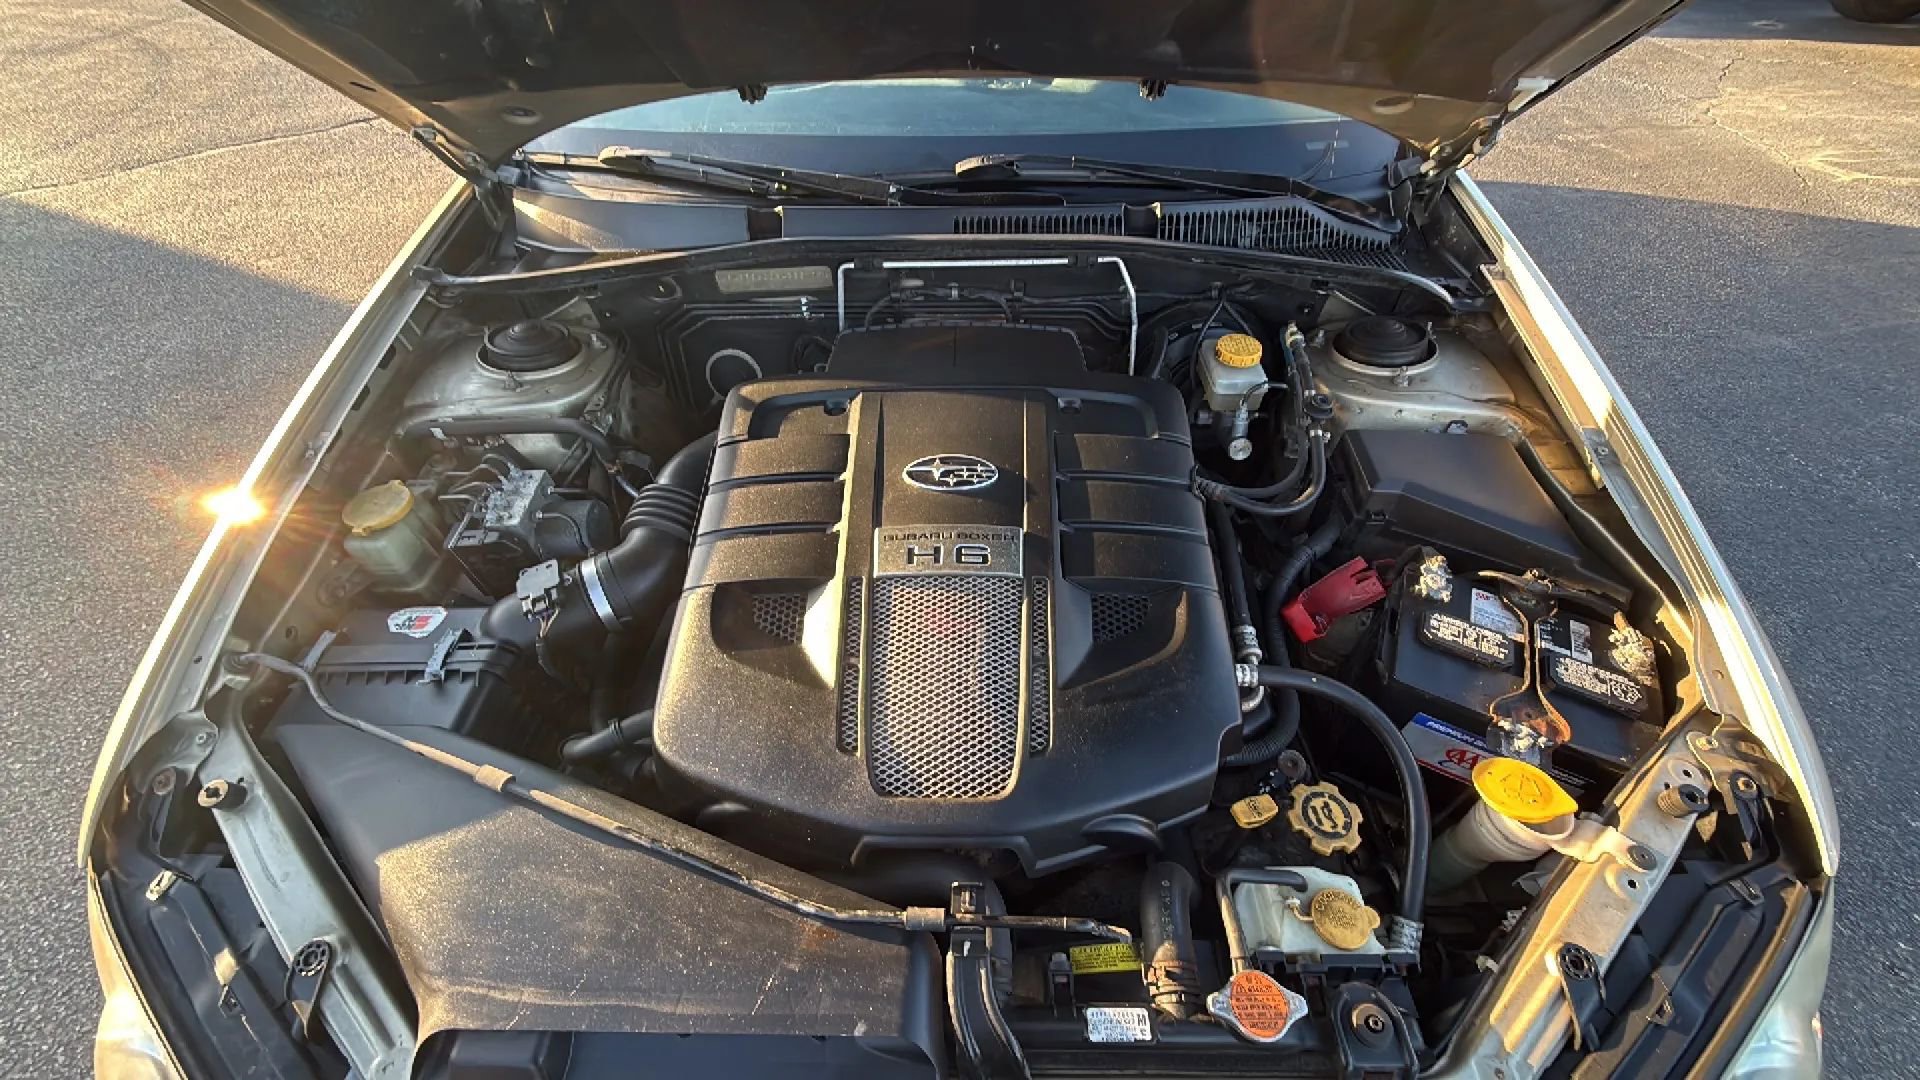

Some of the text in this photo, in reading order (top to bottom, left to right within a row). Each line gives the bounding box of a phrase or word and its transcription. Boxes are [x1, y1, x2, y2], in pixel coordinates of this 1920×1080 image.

[883, 532, 1015, 541] SUBARU BOXER
[906, 543, 991, 566] H6
